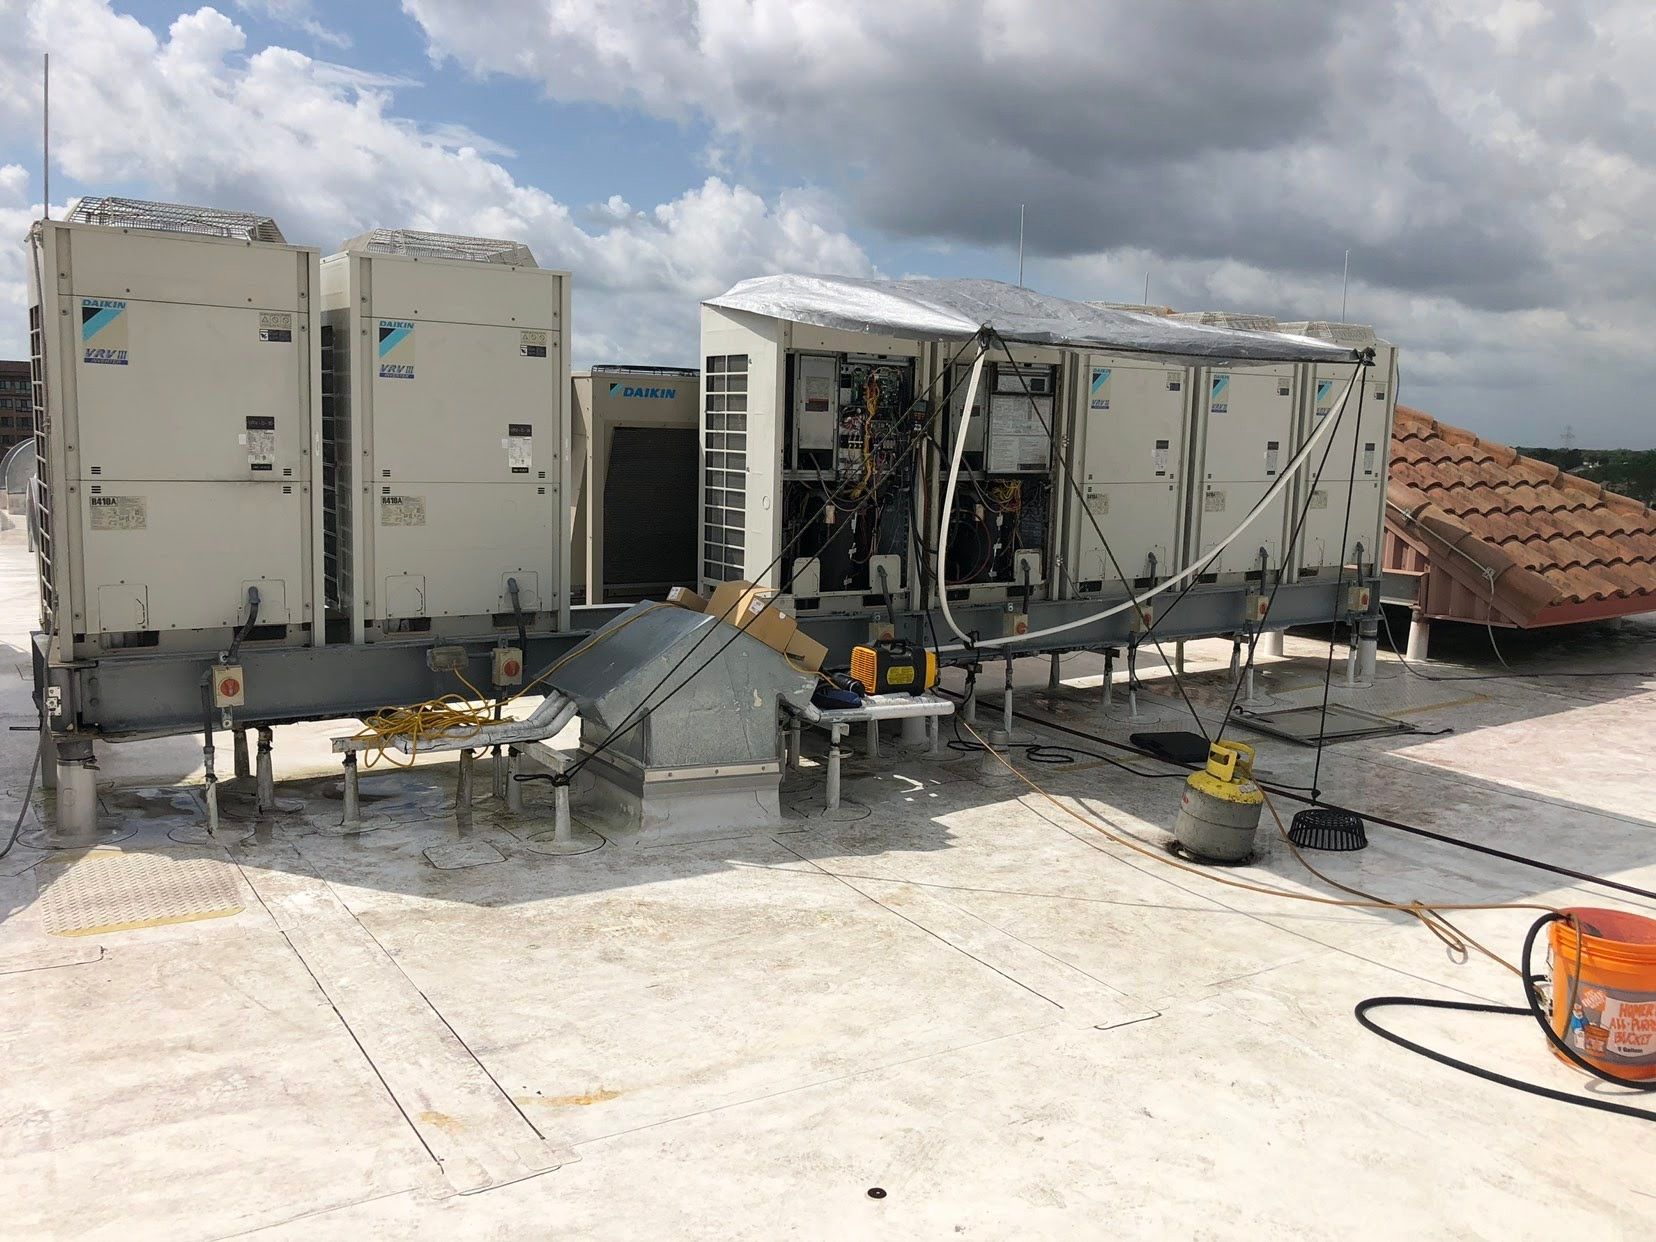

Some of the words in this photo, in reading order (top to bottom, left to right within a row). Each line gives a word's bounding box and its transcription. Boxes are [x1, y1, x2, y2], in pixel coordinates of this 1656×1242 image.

[82, 299, 126, 309] DAIKIN
[379, 320, 415, 329] DAIKIN
[86, 348, 117, 359] VRV
[381, 364, 405, 373] VRV
[623, 387, 676, 399] DAIKIN
[1619, 1003, 1656, 1017] HOMER
[1614, 1031, 1653, 1046] BUCKET
